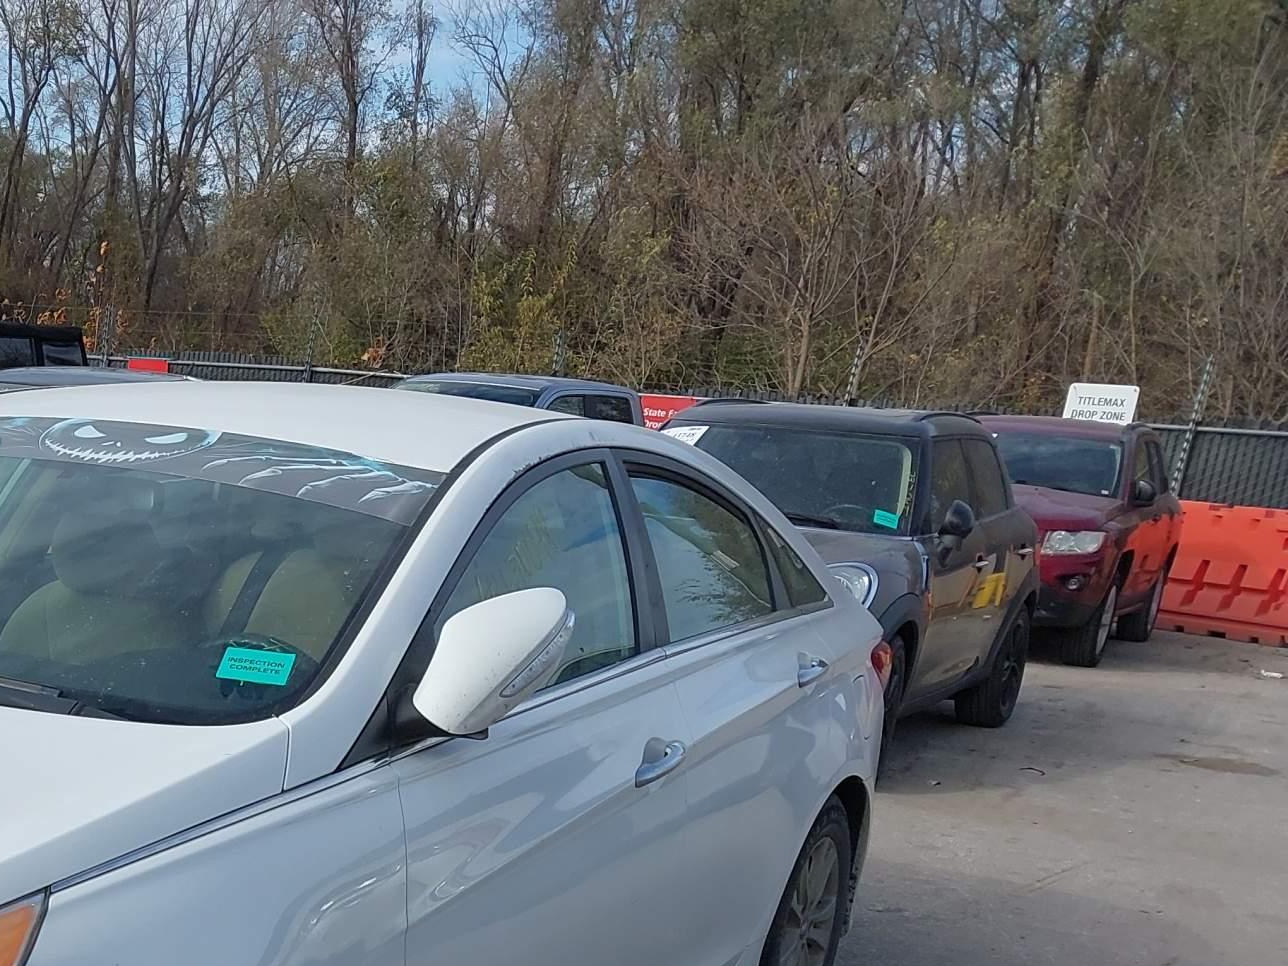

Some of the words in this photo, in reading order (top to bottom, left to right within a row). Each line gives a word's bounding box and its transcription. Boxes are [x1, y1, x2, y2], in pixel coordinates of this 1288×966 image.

[1077, 396, 1127, 408] TITLEMAX
[643, 407, 666, 418] State
[1071, 409, 1098, 420] DROP
[1099, 411, 1126, 421] ZONE
[228, 656, 286, 668] INSPECTION
[229, 664, 281, 675] COMPLETE
